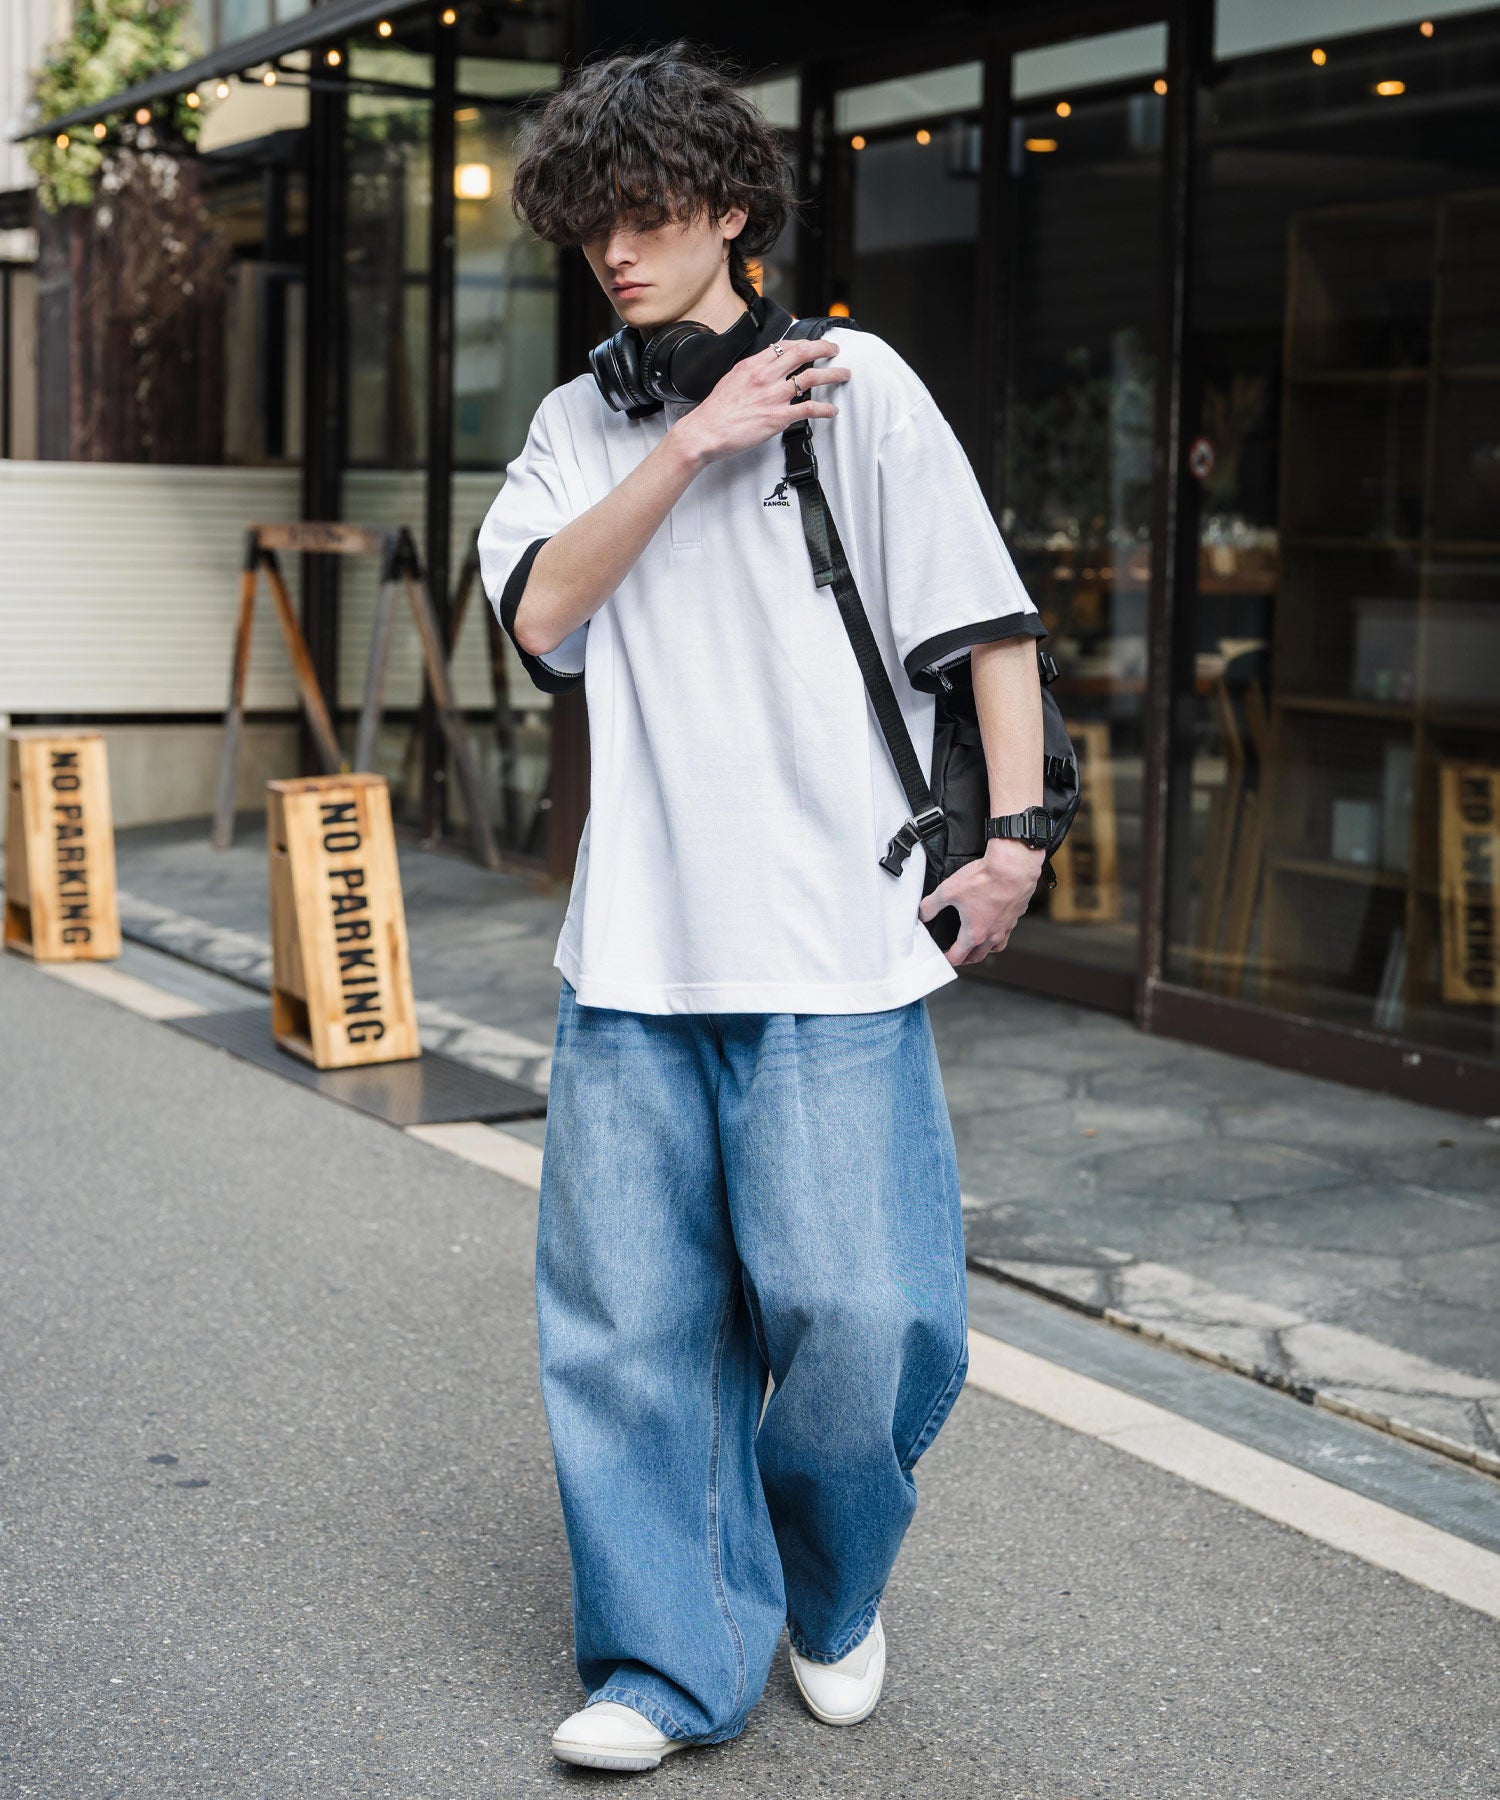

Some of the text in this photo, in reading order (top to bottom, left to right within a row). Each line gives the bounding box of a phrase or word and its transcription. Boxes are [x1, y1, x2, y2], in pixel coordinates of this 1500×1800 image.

[50, 751, 92, 946] NO PARKING
[320, 801, 386, 1045] NO PARKING
